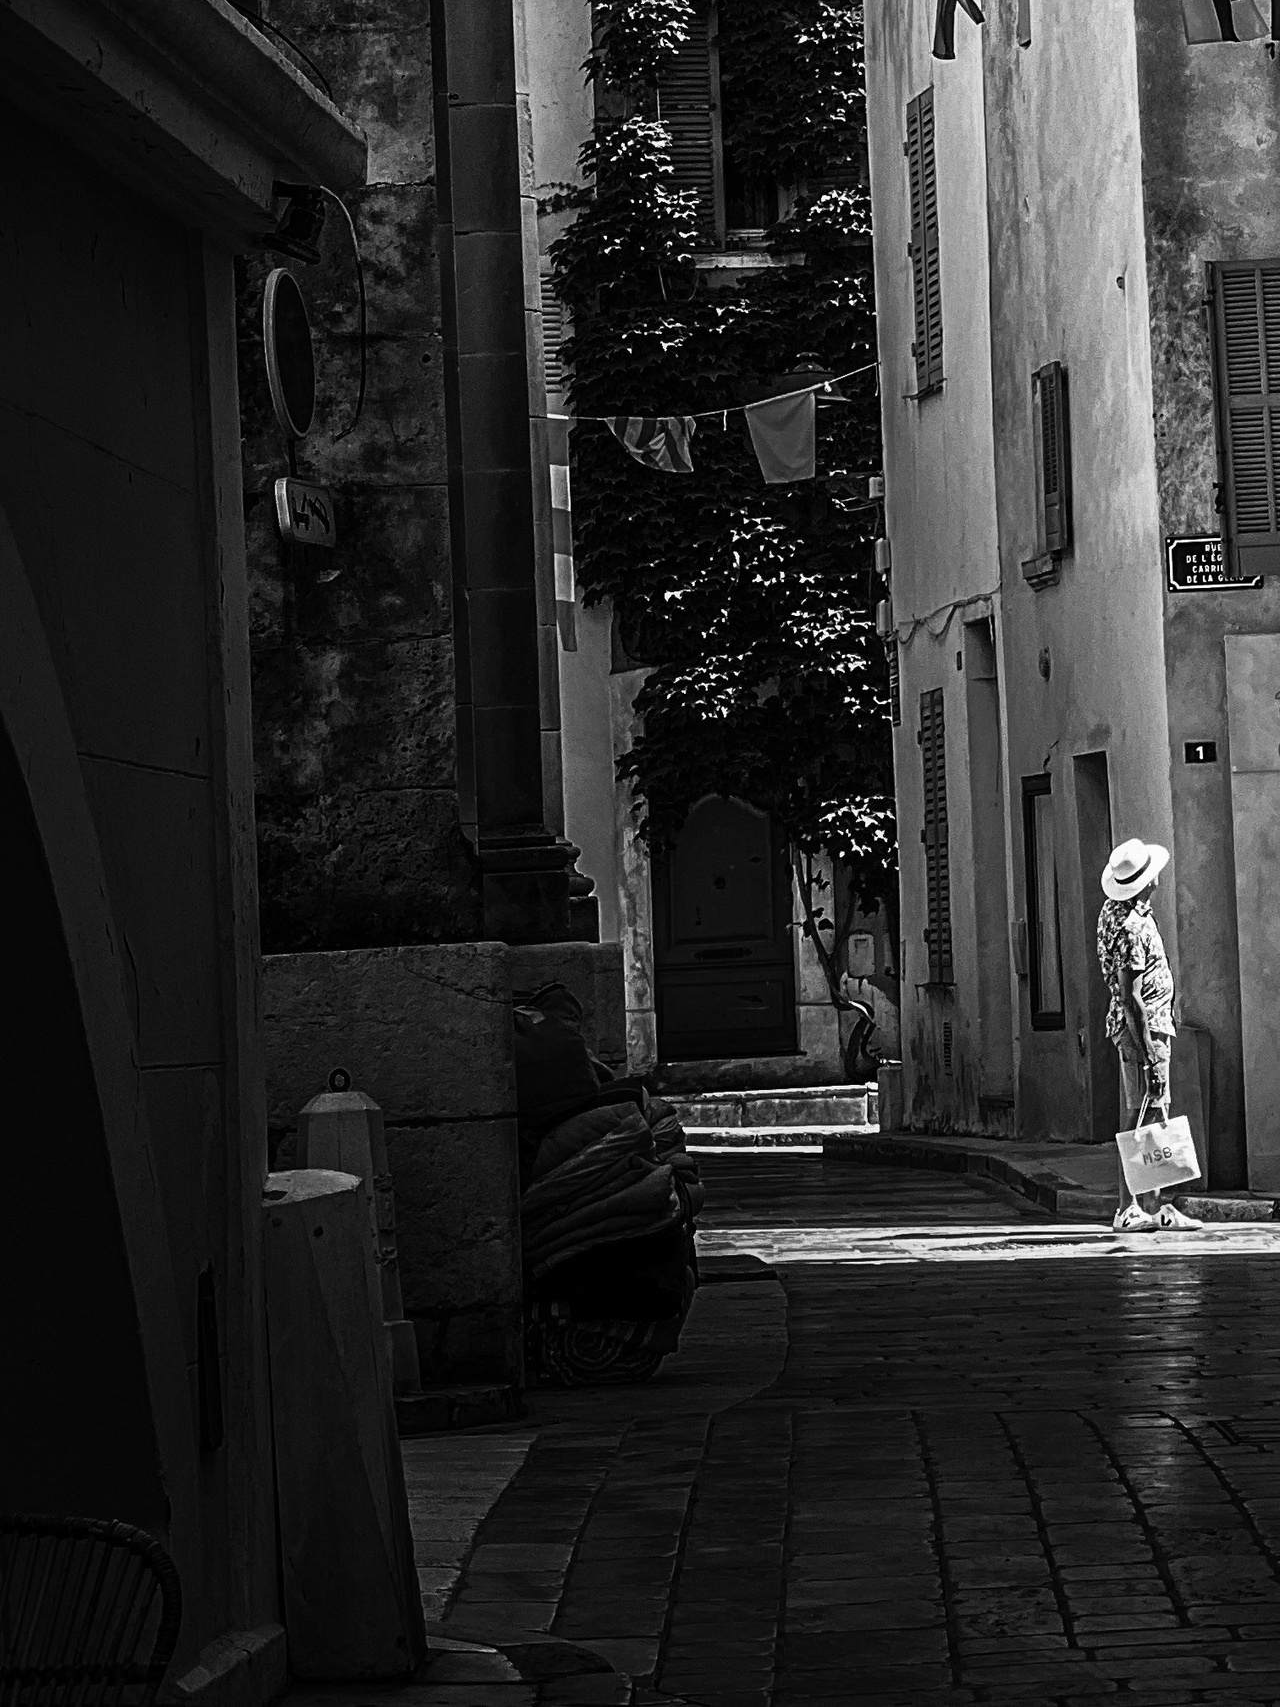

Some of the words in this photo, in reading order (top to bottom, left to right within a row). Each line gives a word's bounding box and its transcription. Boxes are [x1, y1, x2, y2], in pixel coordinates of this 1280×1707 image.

[1186, 554, 1197, 563] DE
[1186, 574, 1198, 584] DE
[1202, 574, 1214, 583] LA
[1195, 745, 1204, 760] 1
